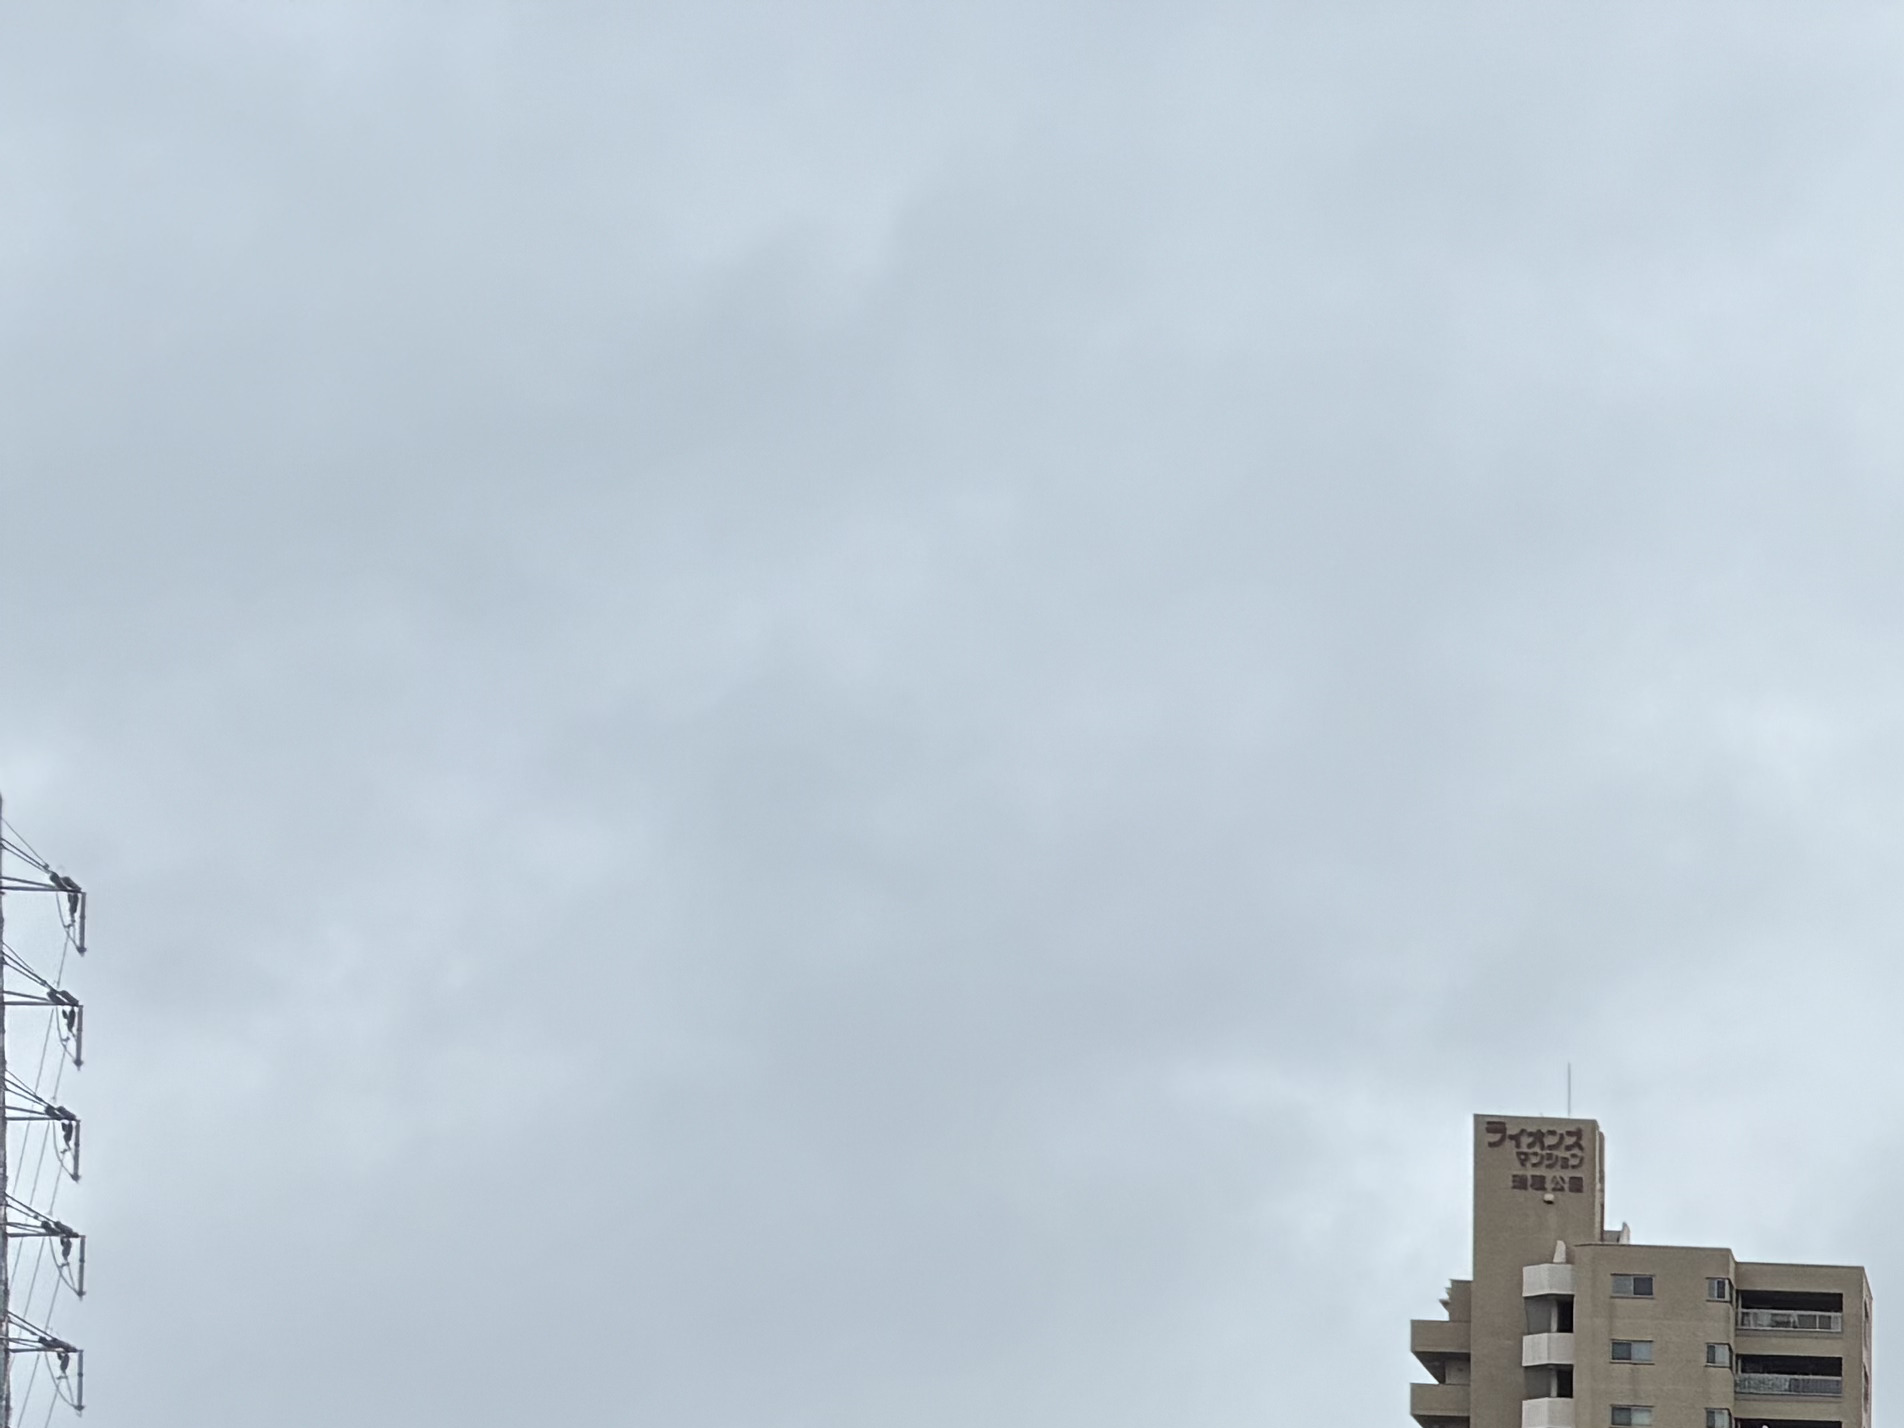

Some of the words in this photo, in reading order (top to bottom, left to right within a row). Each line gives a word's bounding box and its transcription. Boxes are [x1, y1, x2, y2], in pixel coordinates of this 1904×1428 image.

[1484, 1120, 1584, 1152] ライオンズ
[1515, 1150, 1584, 1170] マンション
